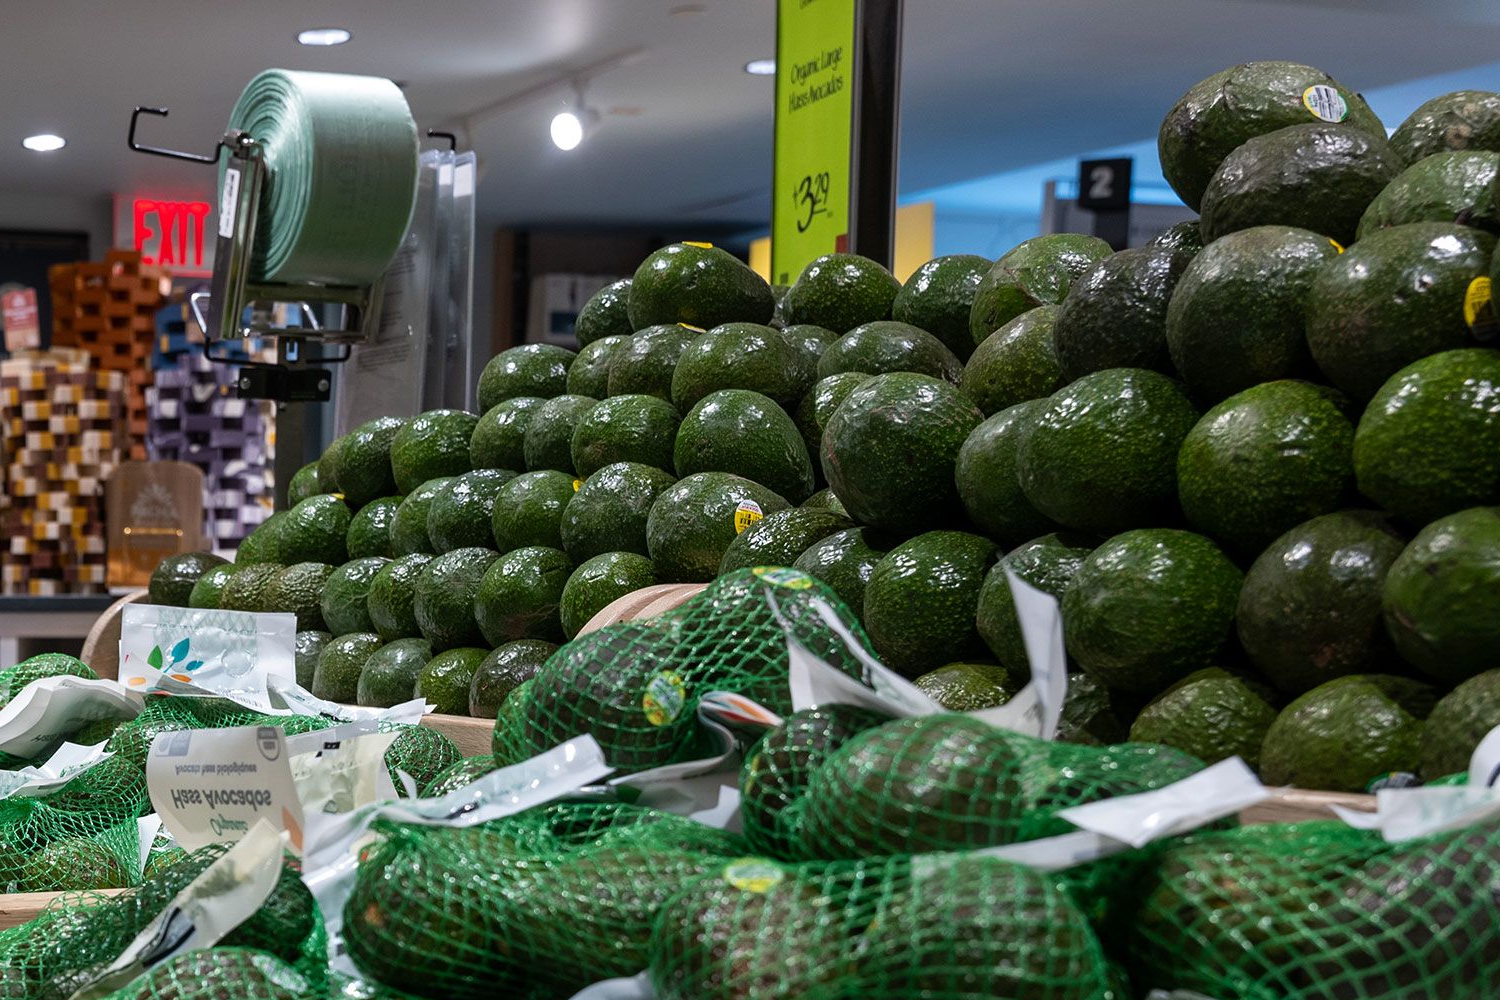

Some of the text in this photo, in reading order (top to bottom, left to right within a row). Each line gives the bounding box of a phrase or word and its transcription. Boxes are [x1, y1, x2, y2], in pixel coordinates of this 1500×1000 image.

[791, 47, 843, 86] Organic Large
[1089, 165, 1115, 200] 2
[133, 197, 212, 268] EXIT
